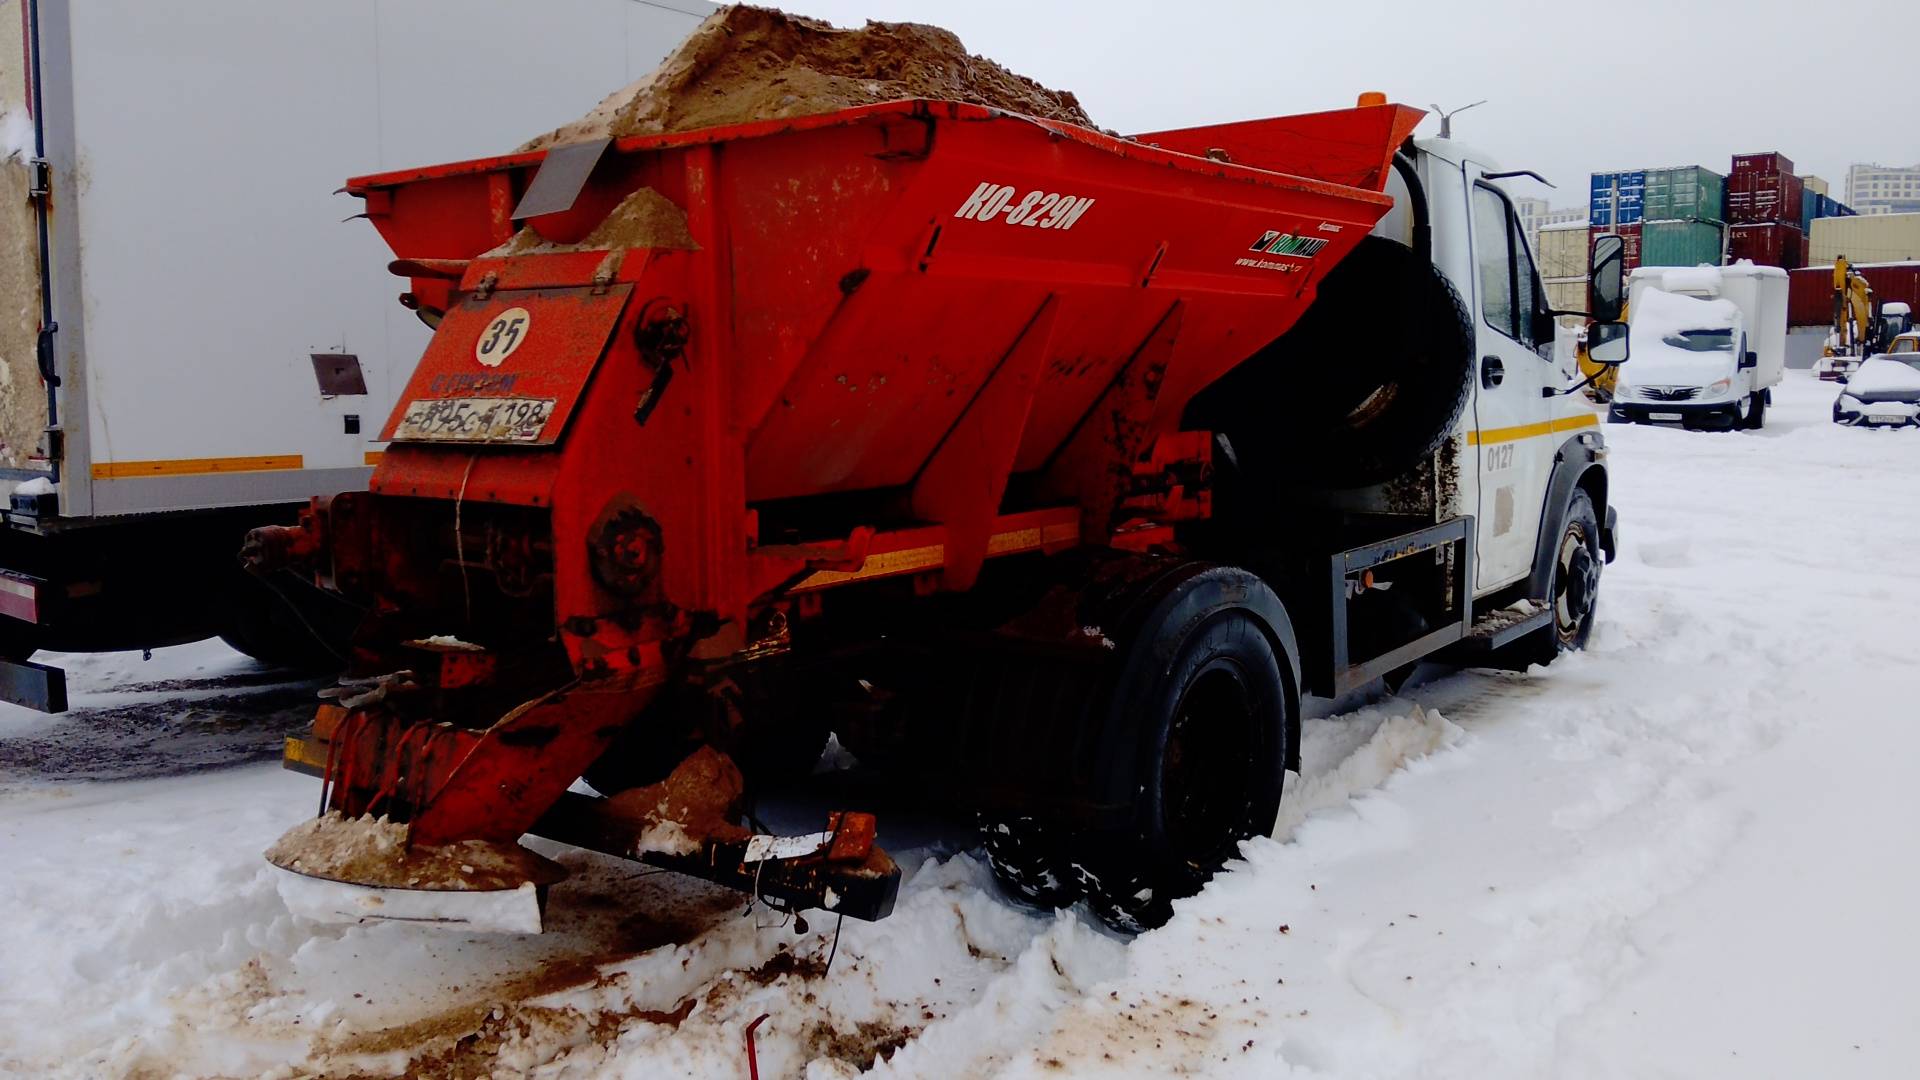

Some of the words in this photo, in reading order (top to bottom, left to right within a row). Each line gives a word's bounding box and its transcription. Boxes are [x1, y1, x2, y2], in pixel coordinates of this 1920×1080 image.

[480, 318, 525, 355] 35
[504, 402, 543, 427] 198
[1487, 443, 1514, 472] 0127
